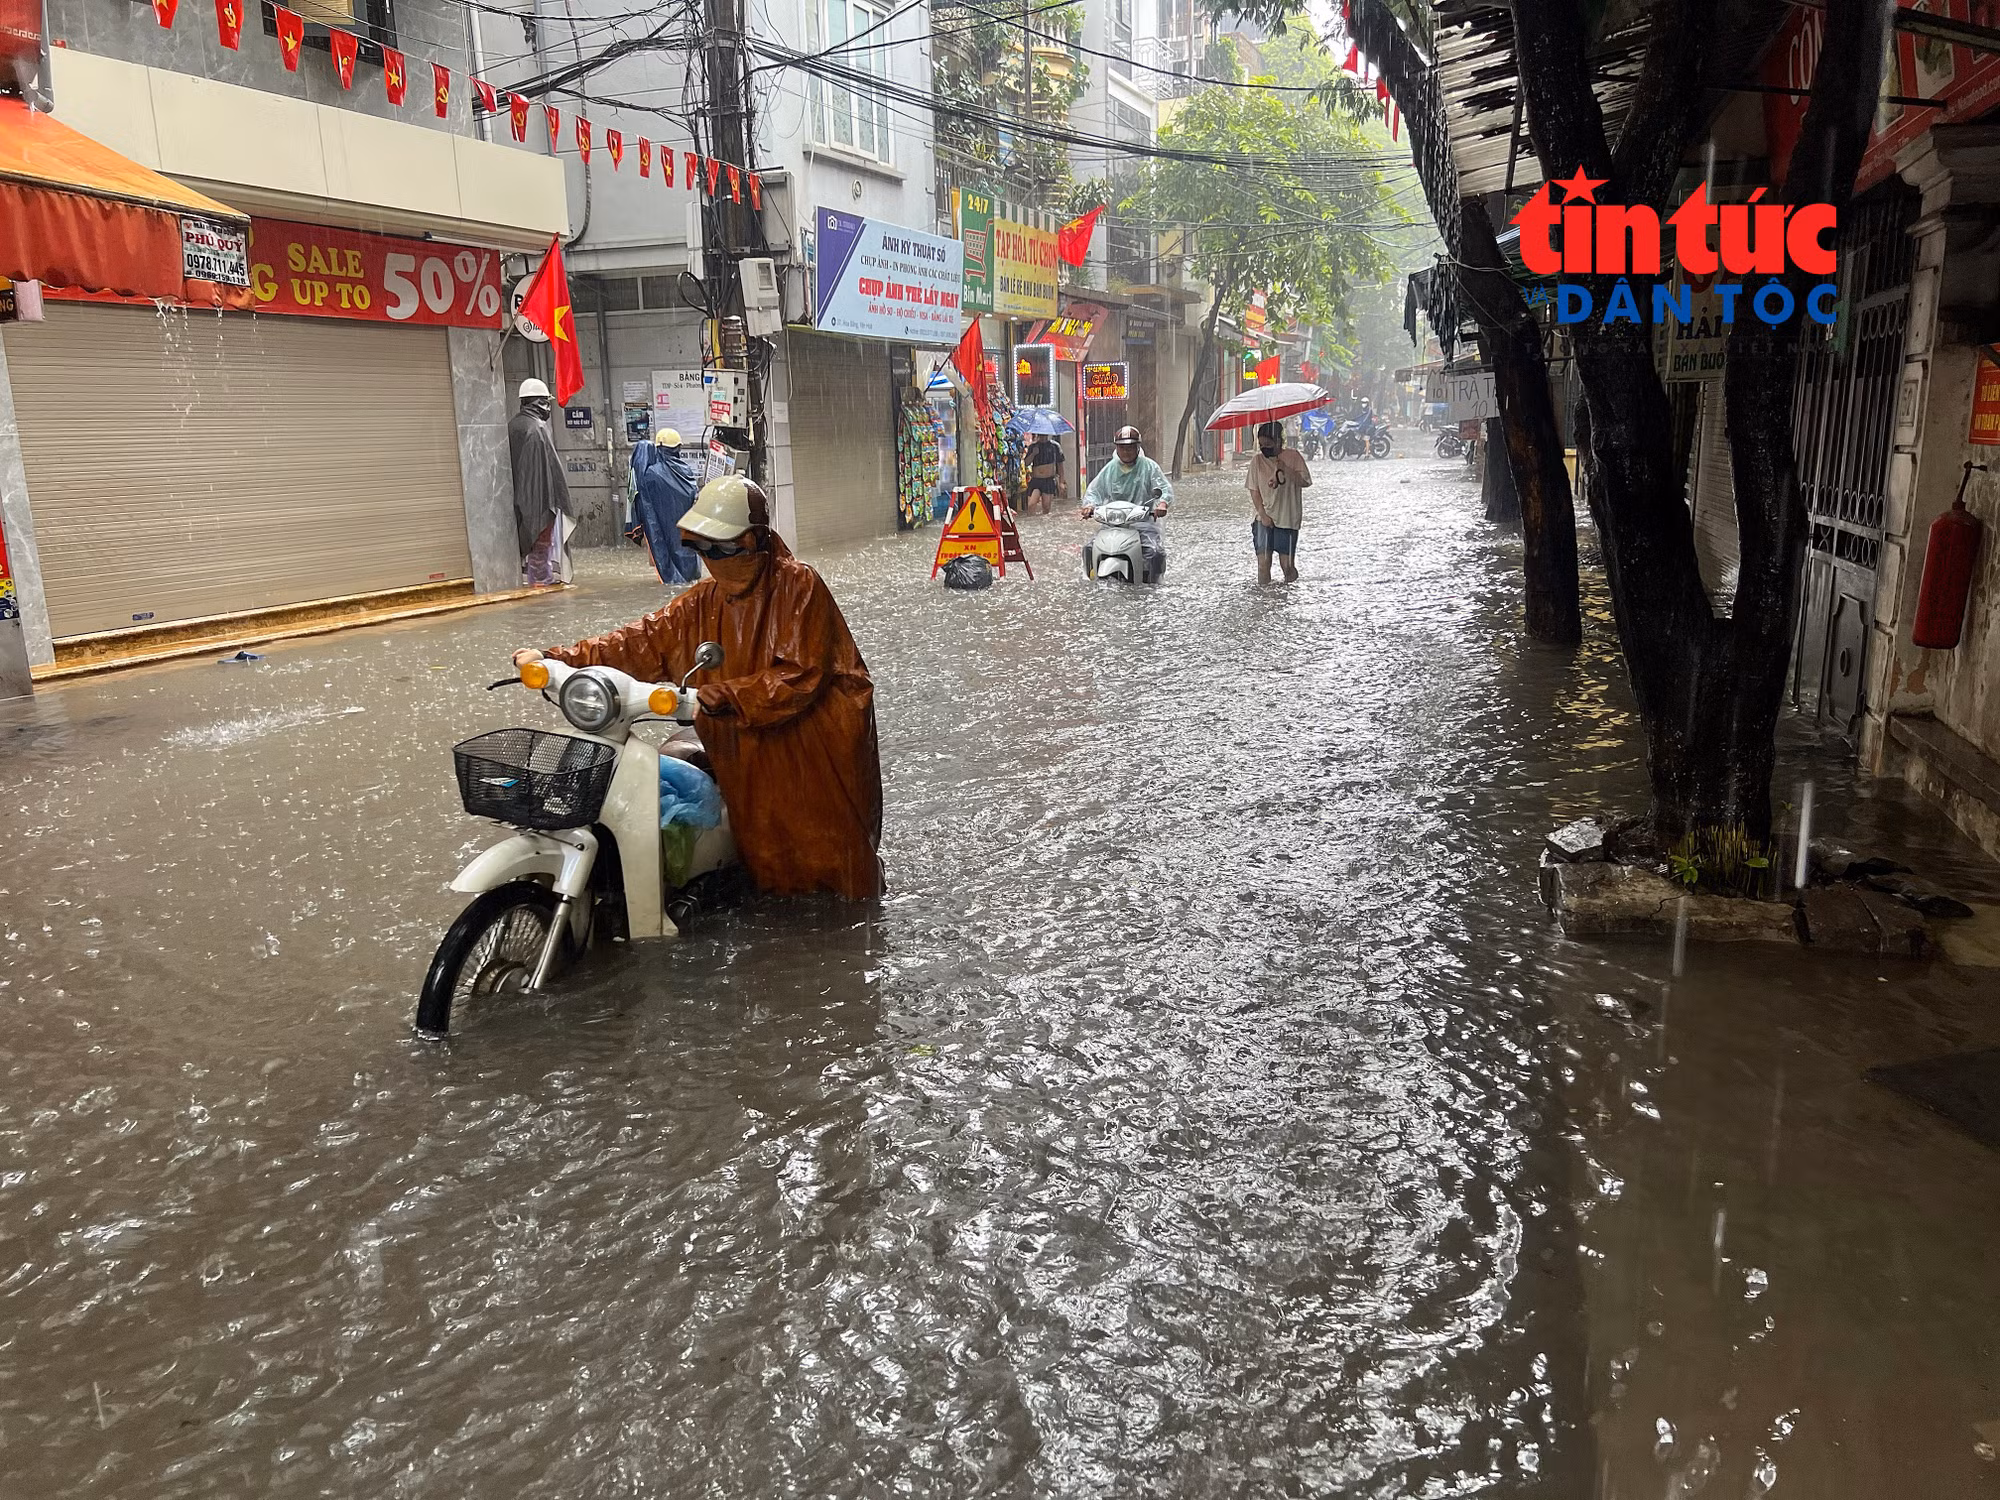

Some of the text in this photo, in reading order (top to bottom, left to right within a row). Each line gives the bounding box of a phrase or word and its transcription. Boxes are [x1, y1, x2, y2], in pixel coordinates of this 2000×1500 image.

[967, 194, 989, 214] 24/7
[185, 231, 214, 246] PHÚ
[217, 238, 243, 252] QUÝ
[882, 232, 899, 253] ẢNH
[913, 240, 936, 262] THUẬT
[937, 244, 946, 263] SỐ
[995, 229, 1011, 267] TẠP
[1012, 227, 1028, 264] HÓA
[1029, 234, 1040, 273] TỰ
[287, 242, 365, 279] SALE
[291, 278, 371, 310] UP TO
[384, 250, 500, 320] 50%
[858, 275, 959, 309] CHỤP ẢNH THẺ LẤY NGAY
[976, 286, 992, 306] Mart
[679, 371, 700, 381] BẢNG
[1449, 375, 1480, 402] TRÀ
